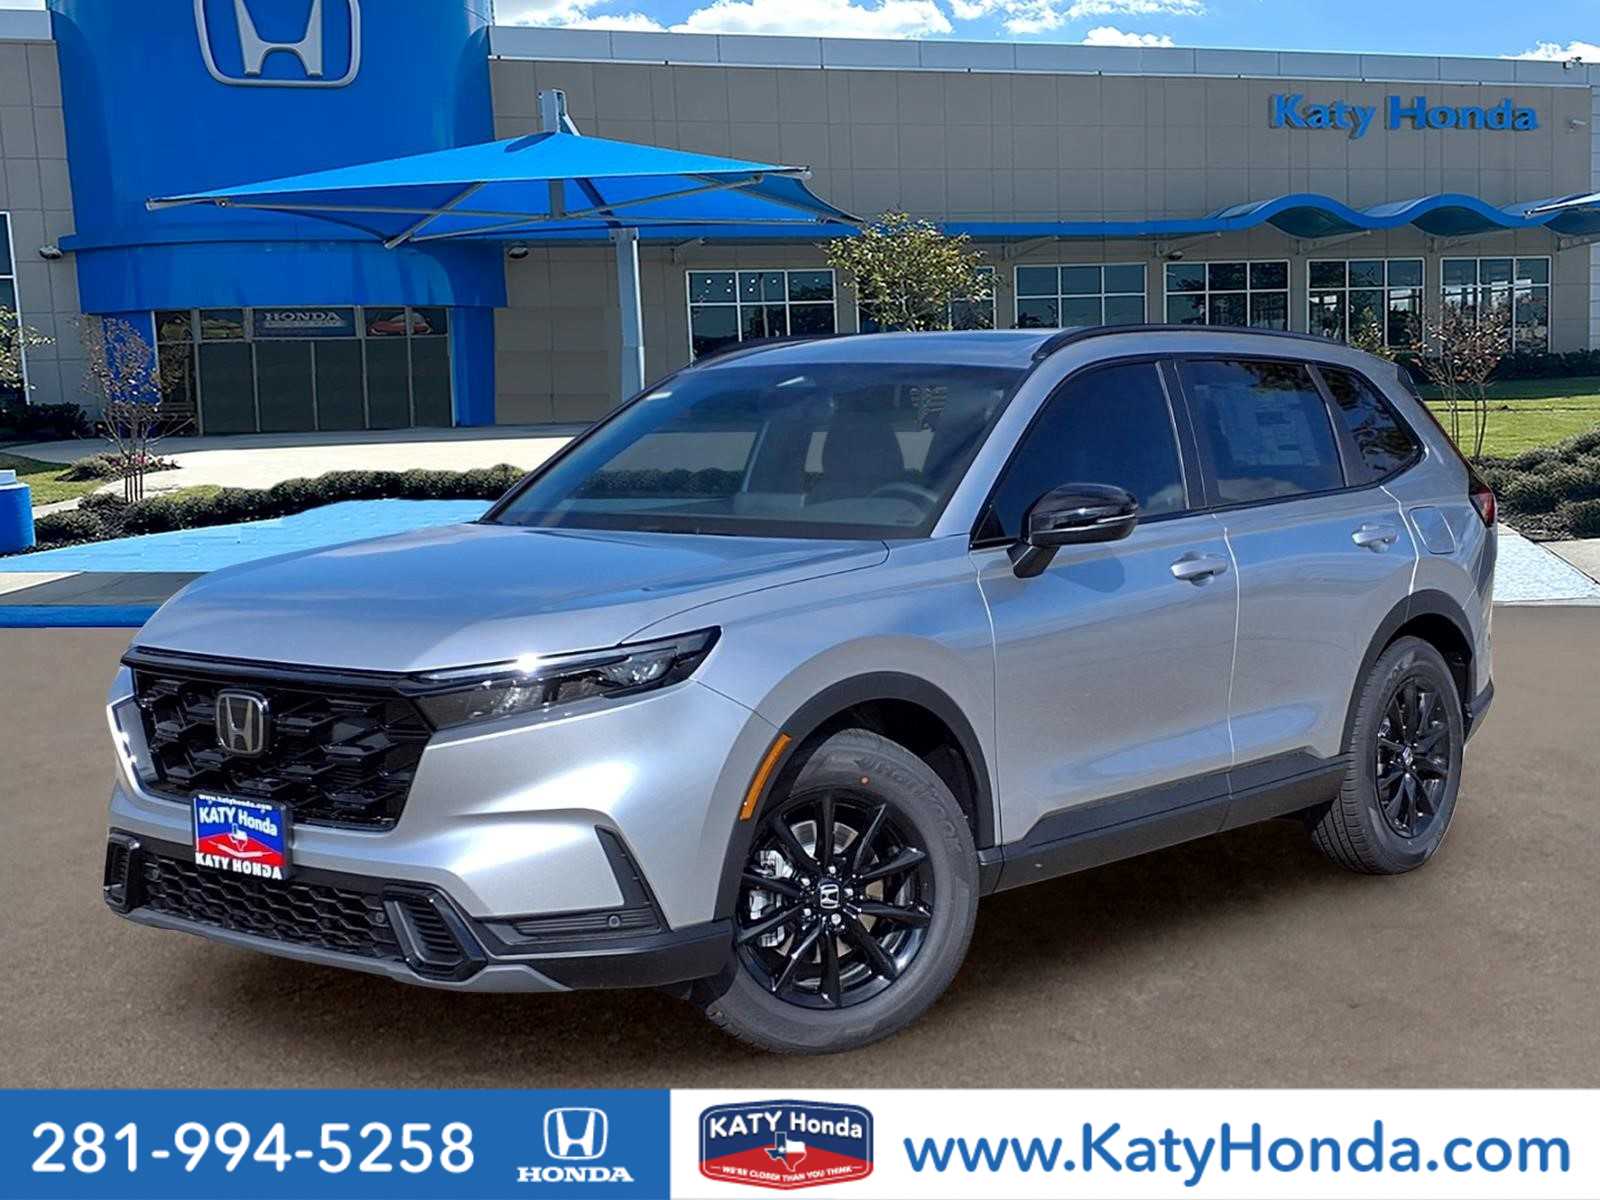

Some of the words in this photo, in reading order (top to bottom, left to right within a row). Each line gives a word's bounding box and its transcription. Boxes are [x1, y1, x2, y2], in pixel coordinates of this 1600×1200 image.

[1269, 93, 1377, 139] Katy
[1384, 95, 1539, 131] Honda
[264, 311, 342, 321] HONDA
[199, 806, 237, 824] KATY
[237, 808, 278, 837] Honda
[195, 851, 230, 871] KATY
[232, 859, 283, 880] HONDA
